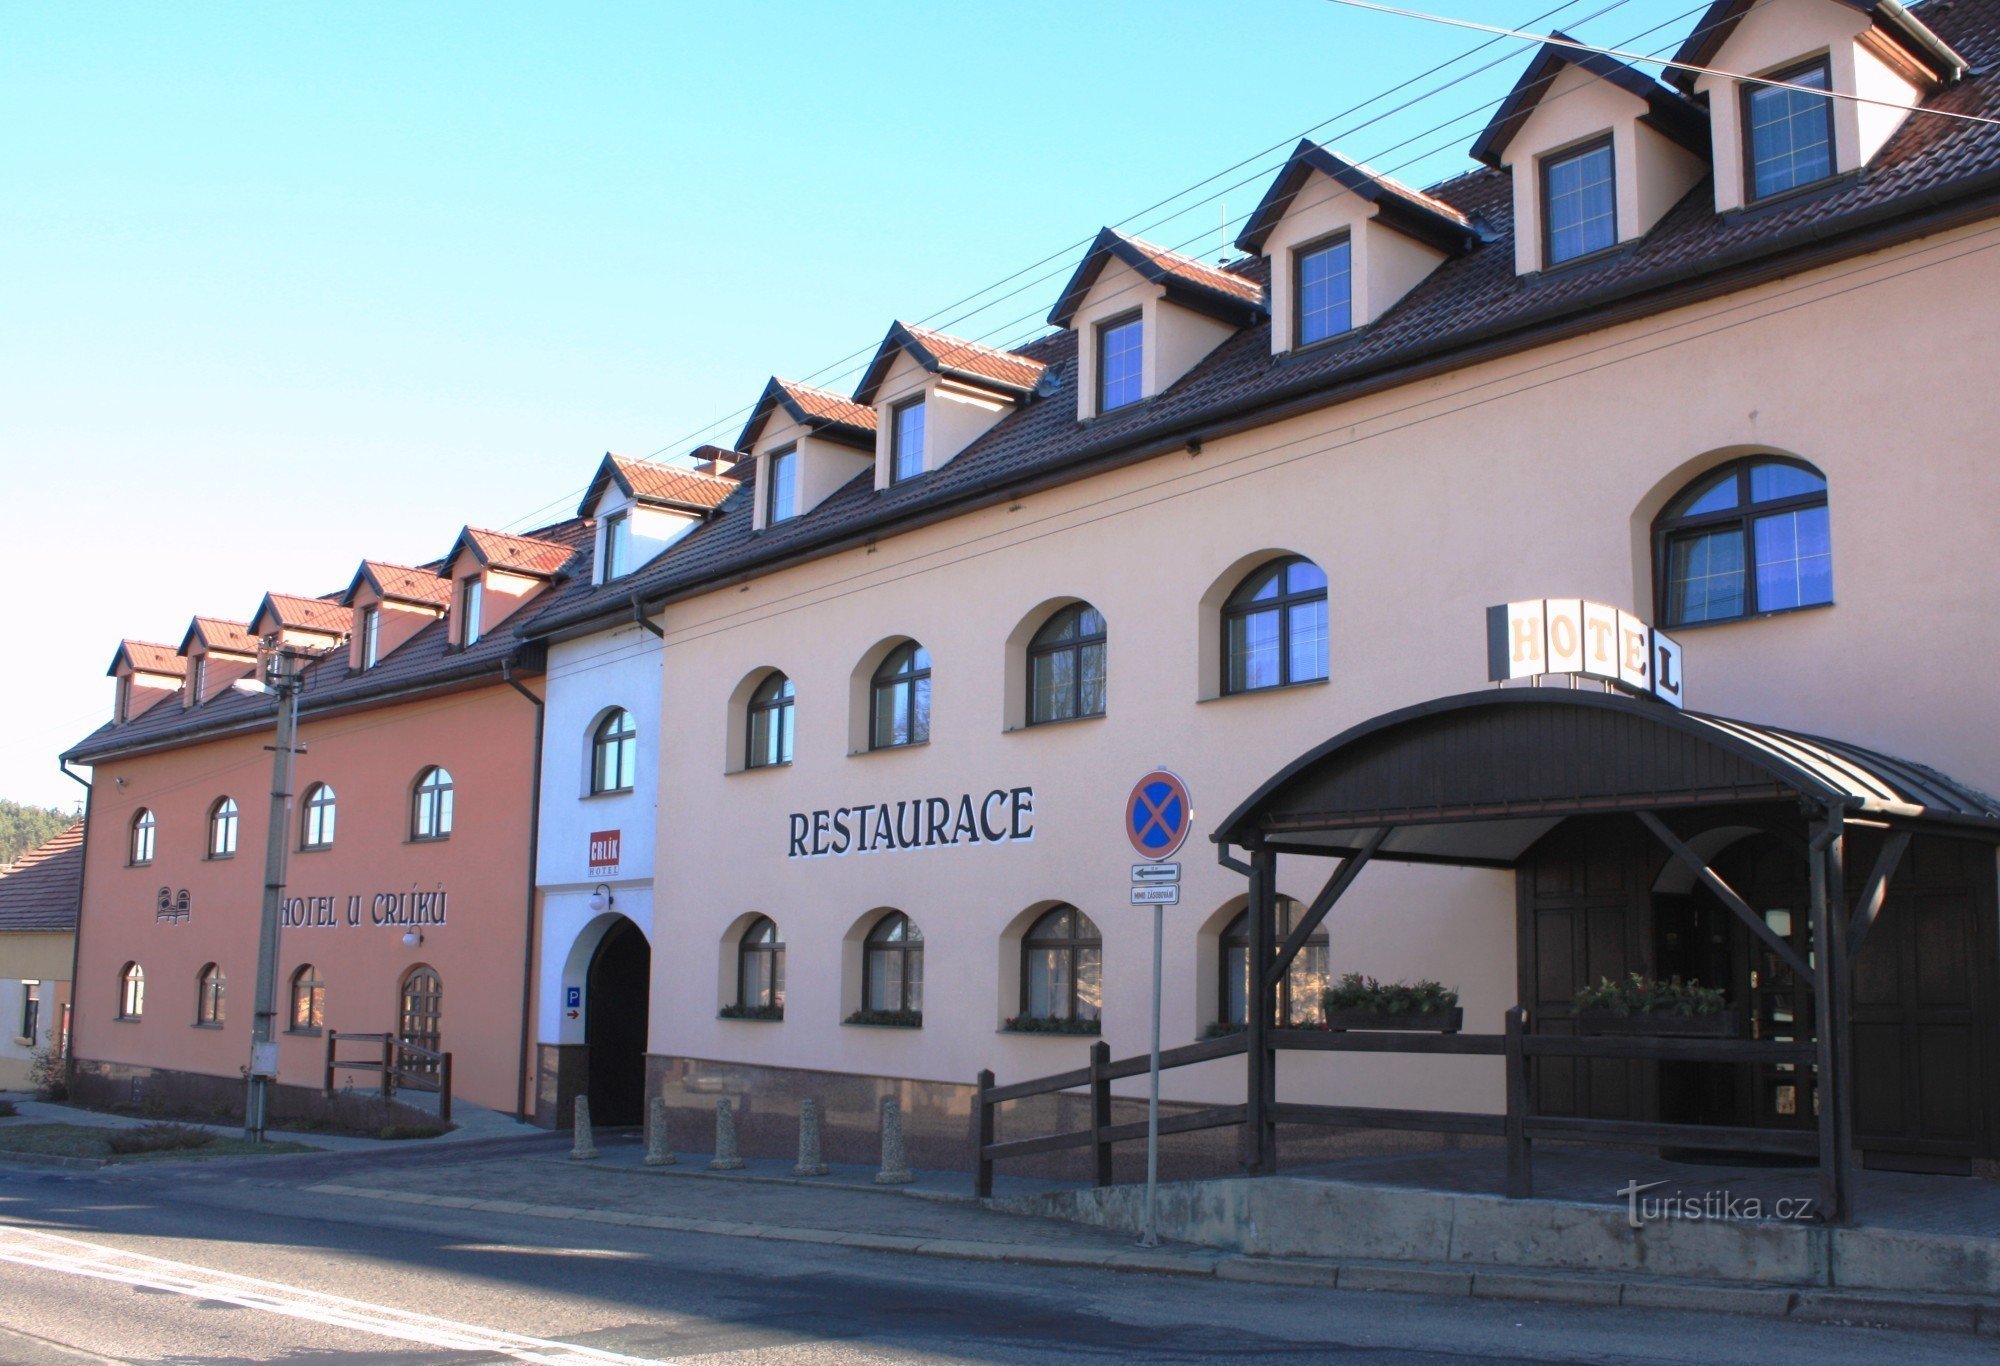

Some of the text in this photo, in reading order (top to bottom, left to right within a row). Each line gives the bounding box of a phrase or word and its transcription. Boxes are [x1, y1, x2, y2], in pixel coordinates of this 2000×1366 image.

[1511, 614, 1680, 696] HOTEL
[788, 786, 1035, 860] RESTAURACE
[589, 866, 619, 876] HOTEL
[347, 895, 362, 928] U
[371, 882, 448, 927] CRLÍKŮ
